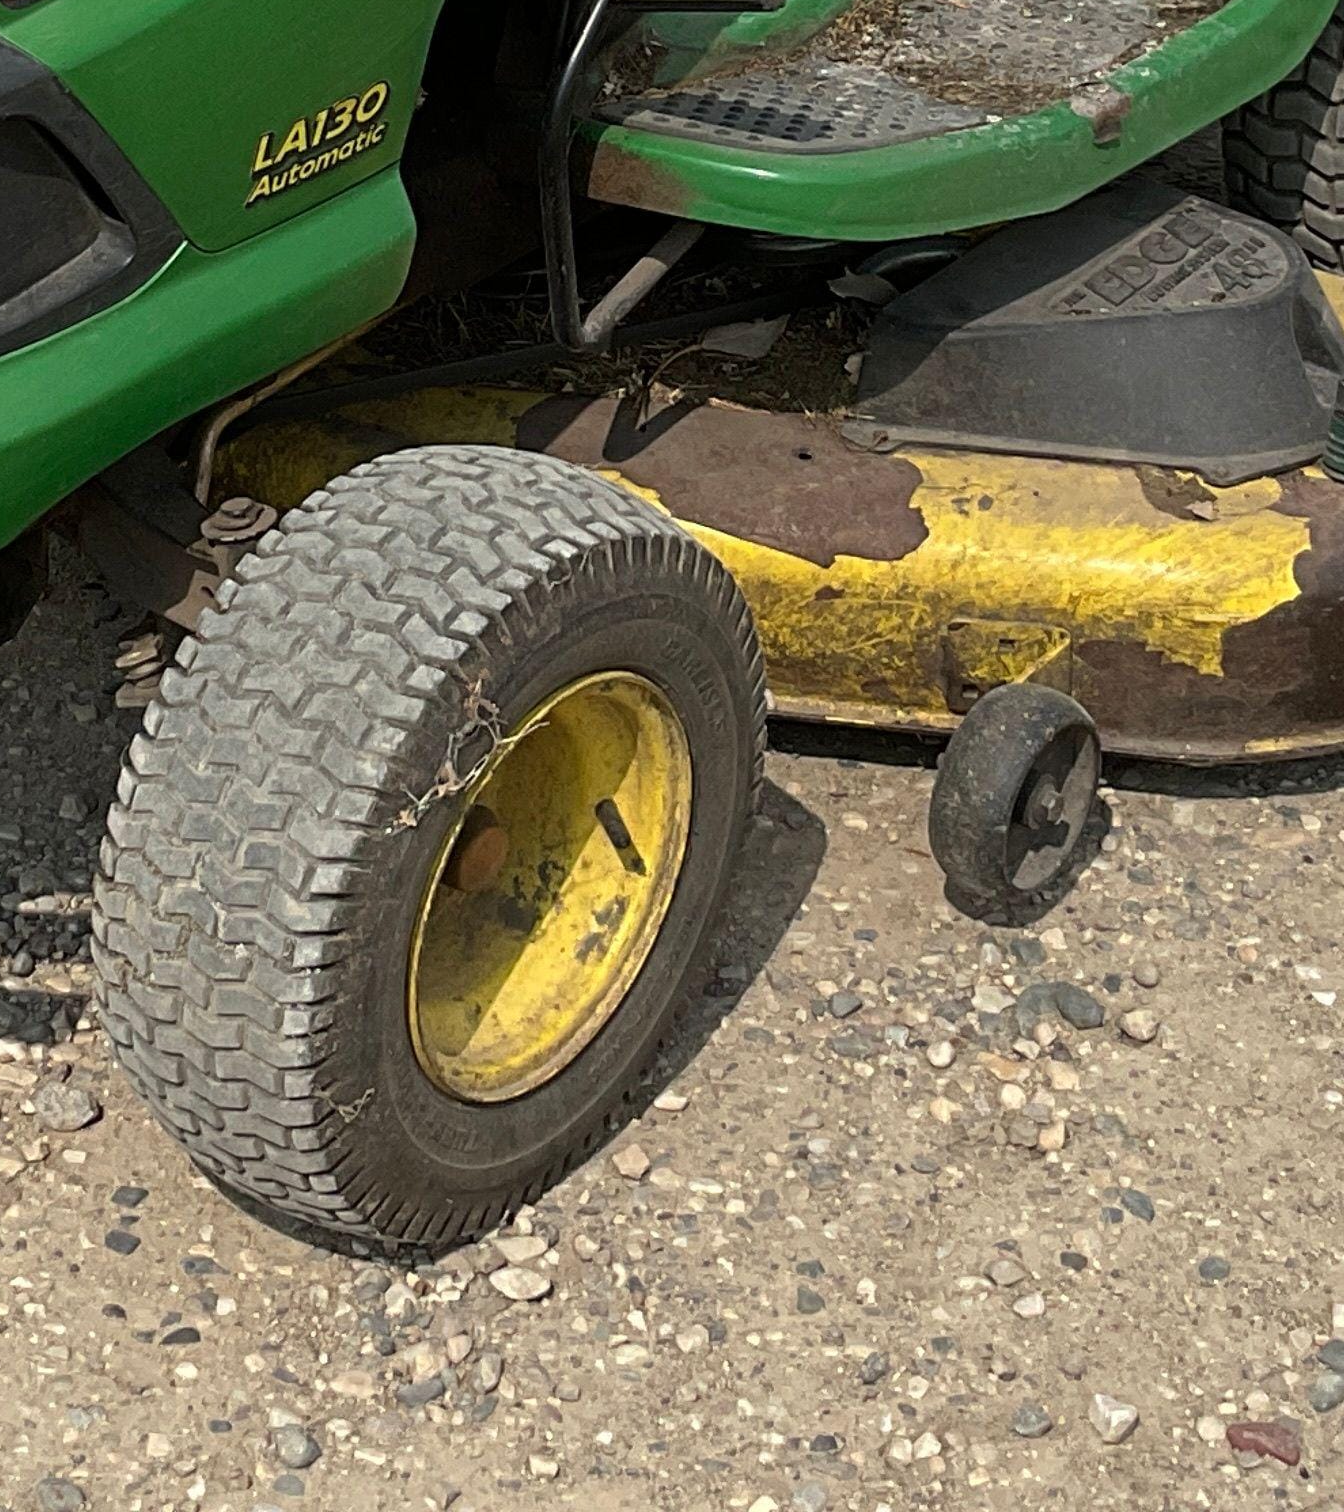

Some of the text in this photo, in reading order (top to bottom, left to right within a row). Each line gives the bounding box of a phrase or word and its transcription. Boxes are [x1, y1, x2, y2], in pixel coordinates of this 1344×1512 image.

[245, 122, 387, 205] Automatic
[253, 80, 390, 173] LA130
[1084, 213, 1213, 307] EDGE
